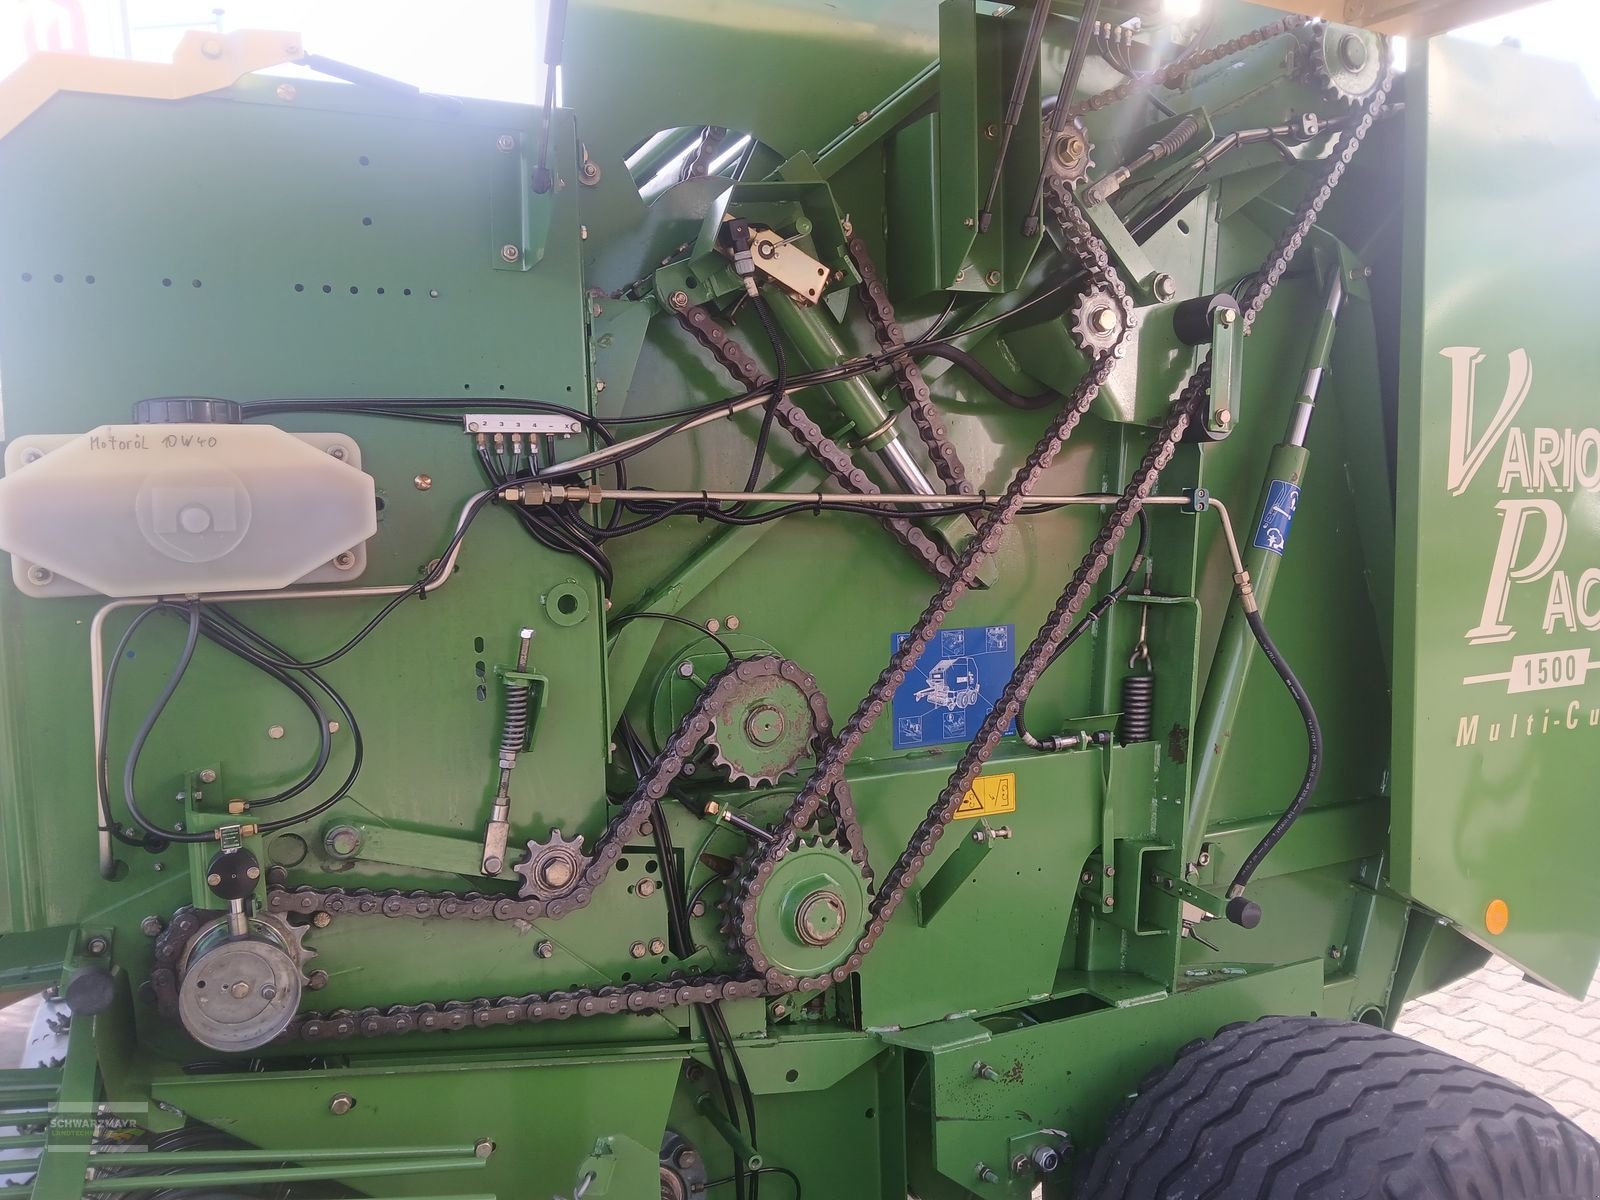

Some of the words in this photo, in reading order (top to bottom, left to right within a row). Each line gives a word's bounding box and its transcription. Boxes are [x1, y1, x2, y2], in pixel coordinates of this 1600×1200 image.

[1438, 346, 1600, 497] VARIO
[1524, 654, 1576, 687] 1500
[1455, 699, 1600, 748] Multi-Cu
